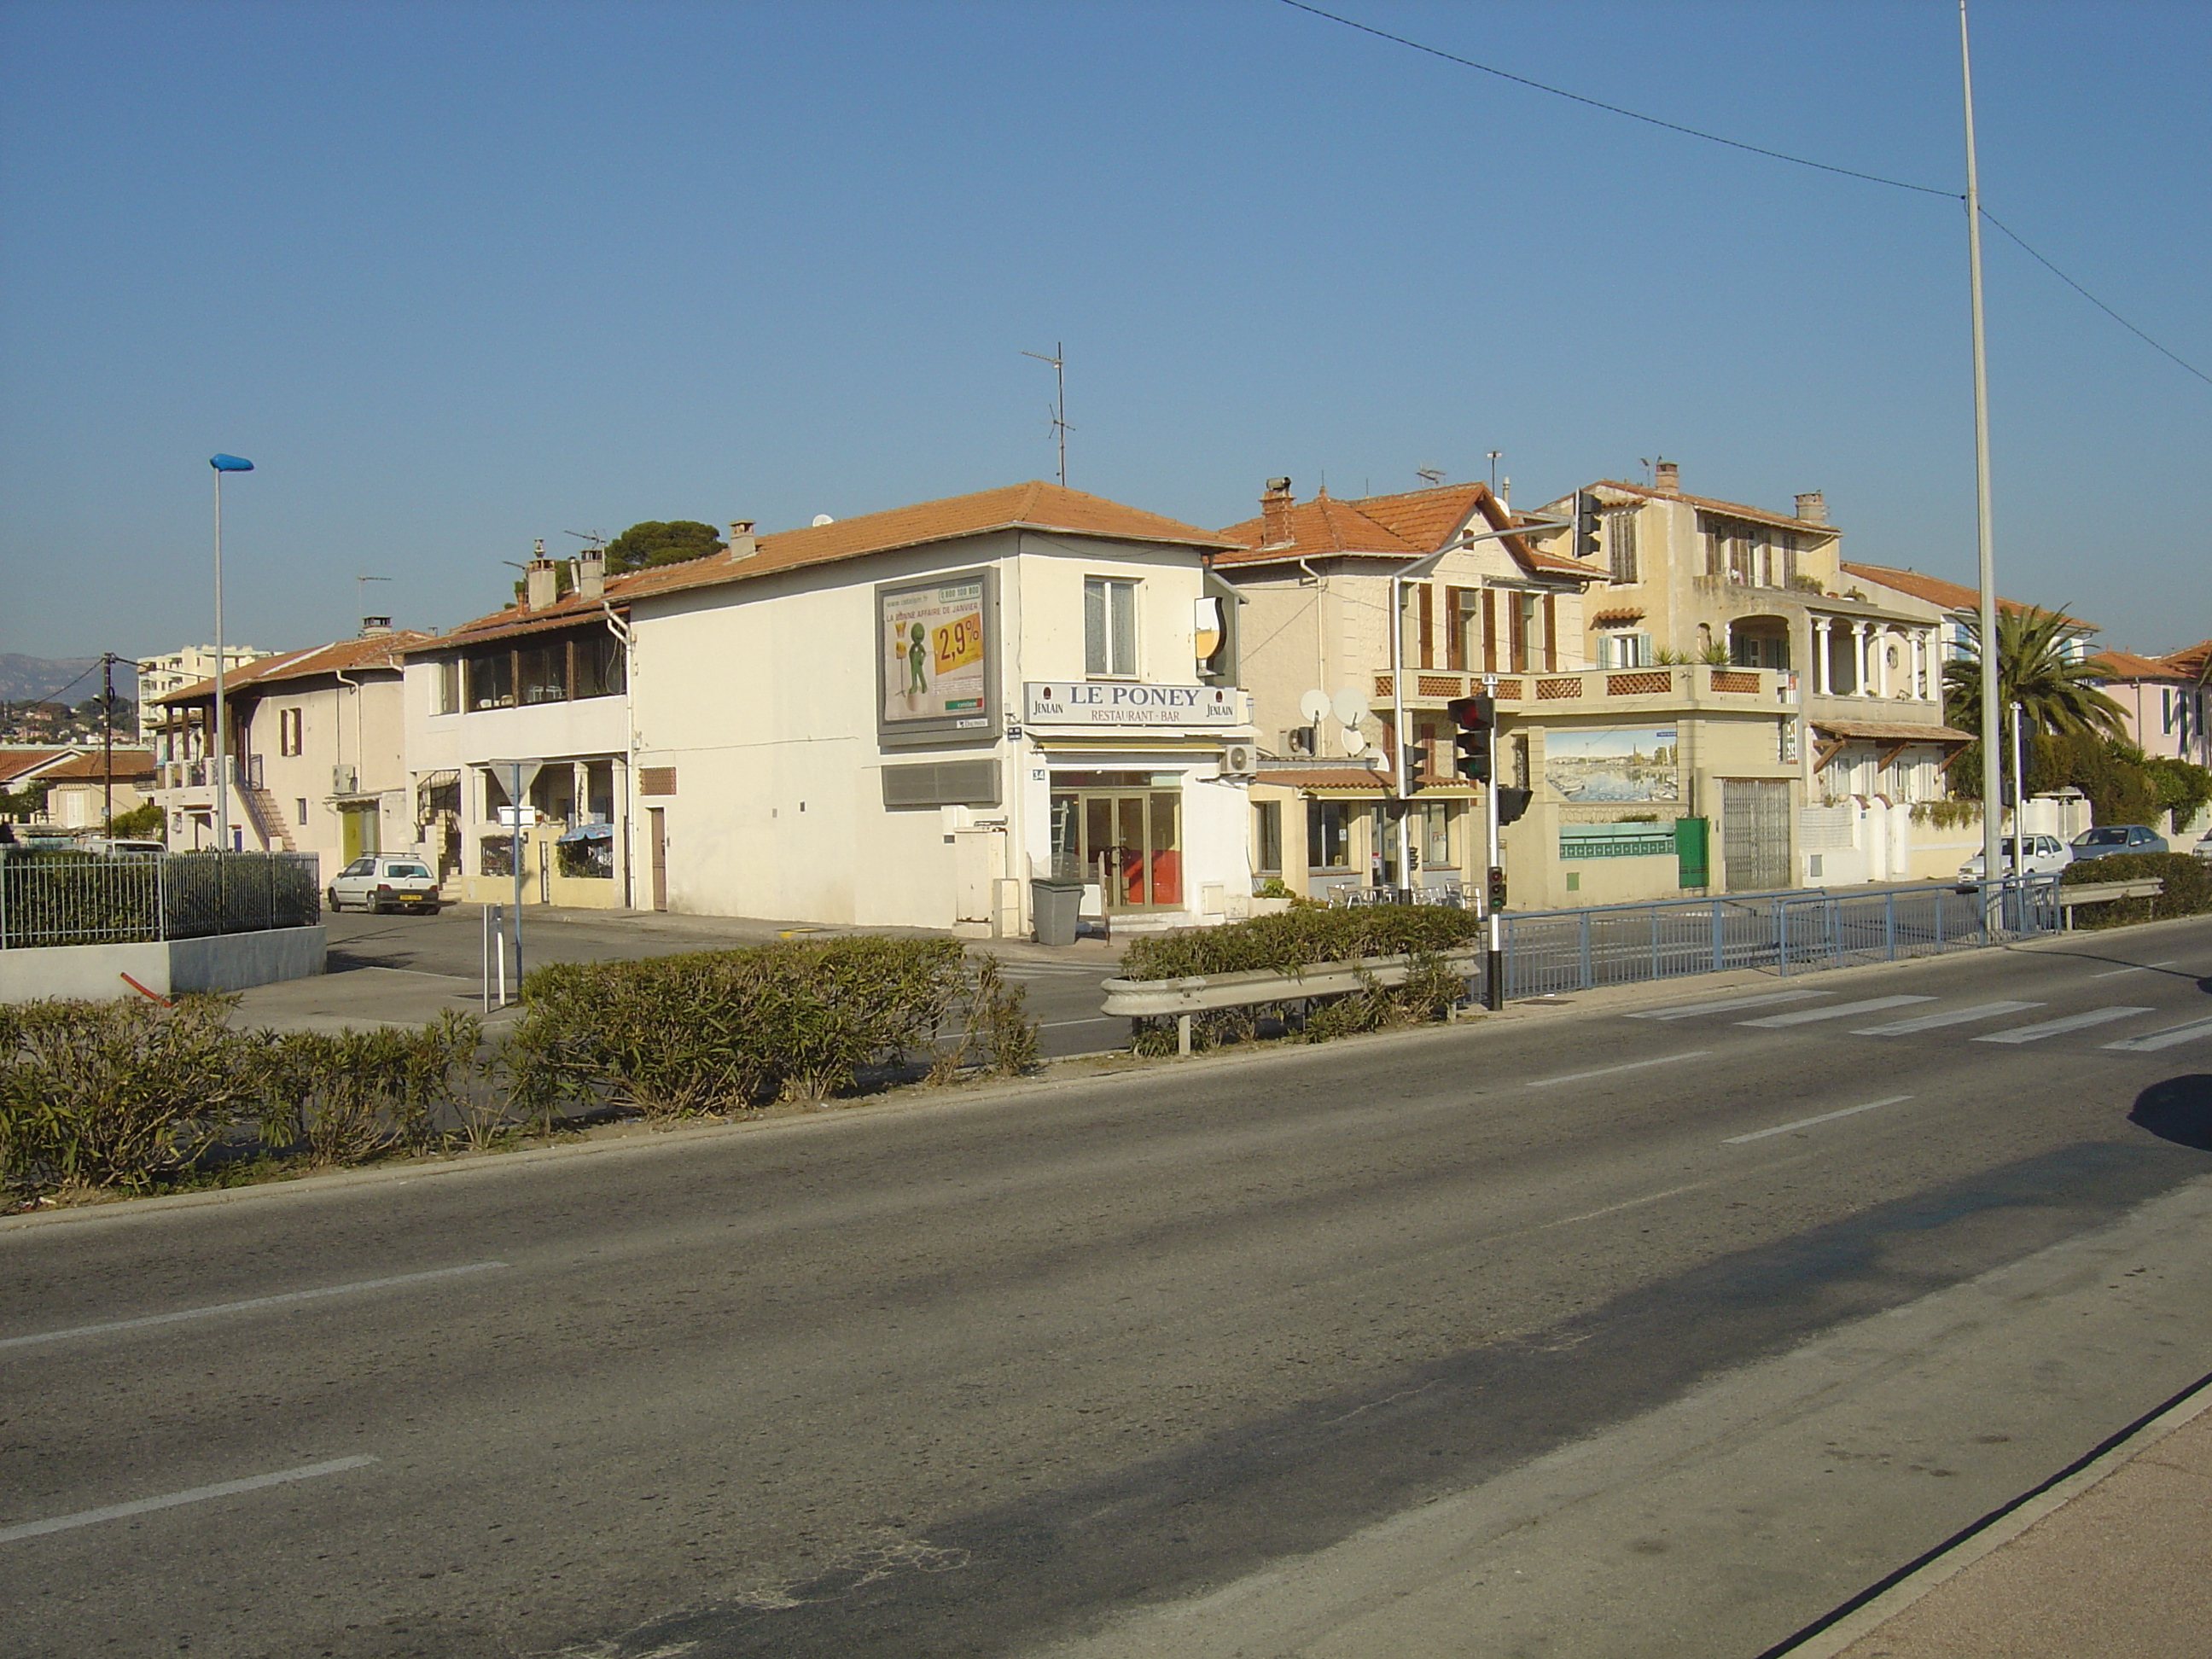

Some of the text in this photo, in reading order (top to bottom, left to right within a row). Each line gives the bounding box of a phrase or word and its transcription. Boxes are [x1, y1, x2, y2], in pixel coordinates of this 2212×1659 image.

[917, 608, 941, 618] AFFAIRE
[952, 602, 978, 614] JANVIER
[1070, 686, 1200, 707] LE PONEY
[1033, 700, 1064, 716] JENLAIN
[1091, 709, 1155, 722] RESTAURANT
[1161, 711, 1180, 722] BAR
[1206, 703, 1234, 718] JENLAIN
[1033, 770, 1045, 780] 34
